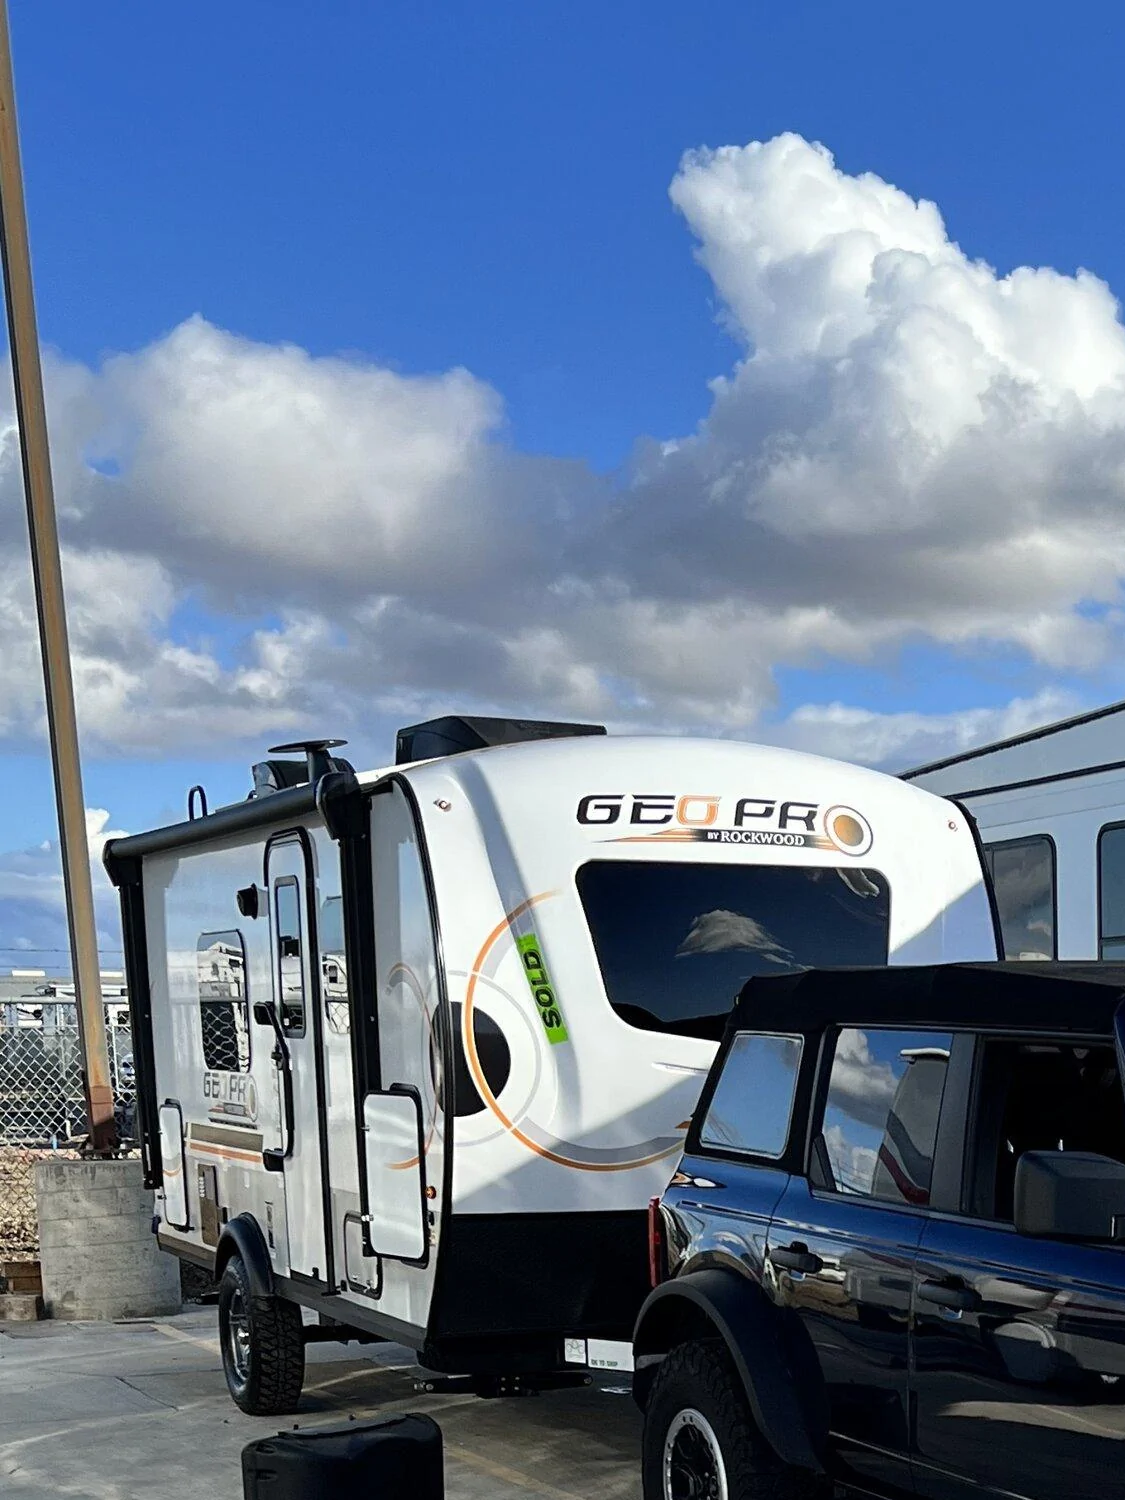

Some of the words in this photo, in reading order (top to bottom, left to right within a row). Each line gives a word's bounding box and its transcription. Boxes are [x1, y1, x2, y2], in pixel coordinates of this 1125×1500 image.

[576, 794, 721, 825] GEO
[734, 798, 873, 857] PRO
[707, 831, 719, 840] BY
[720, 831, 805, 846] ROCKWOOD
[523, 948, 562, 1029] SOLD
